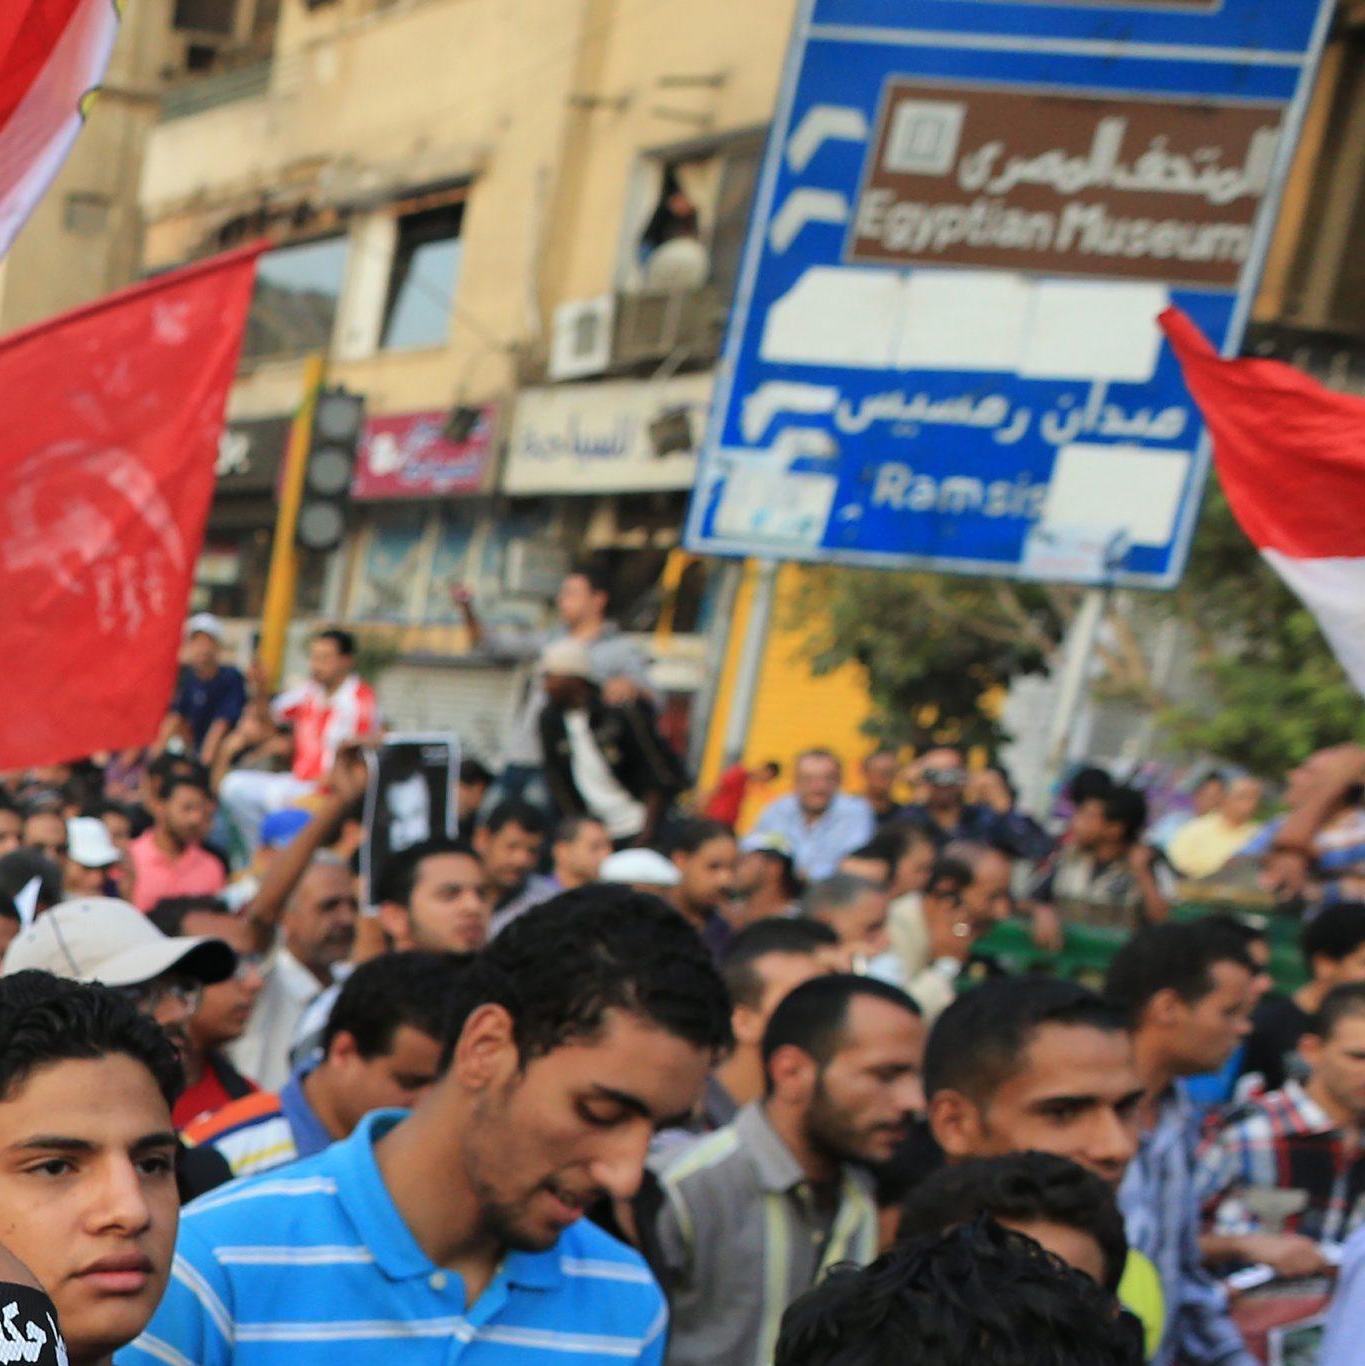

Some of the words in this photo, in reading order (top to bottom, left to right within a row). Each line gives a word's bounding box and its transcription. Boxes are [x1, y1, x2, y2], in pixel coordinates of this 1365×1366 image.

[855, 190, 1055, 255] Egyptian
[1055, 203, 1251, 262] Museum
[834, 388, 1032, 447] رمسيس
[1039, 381, 1188, 447] ميدان
